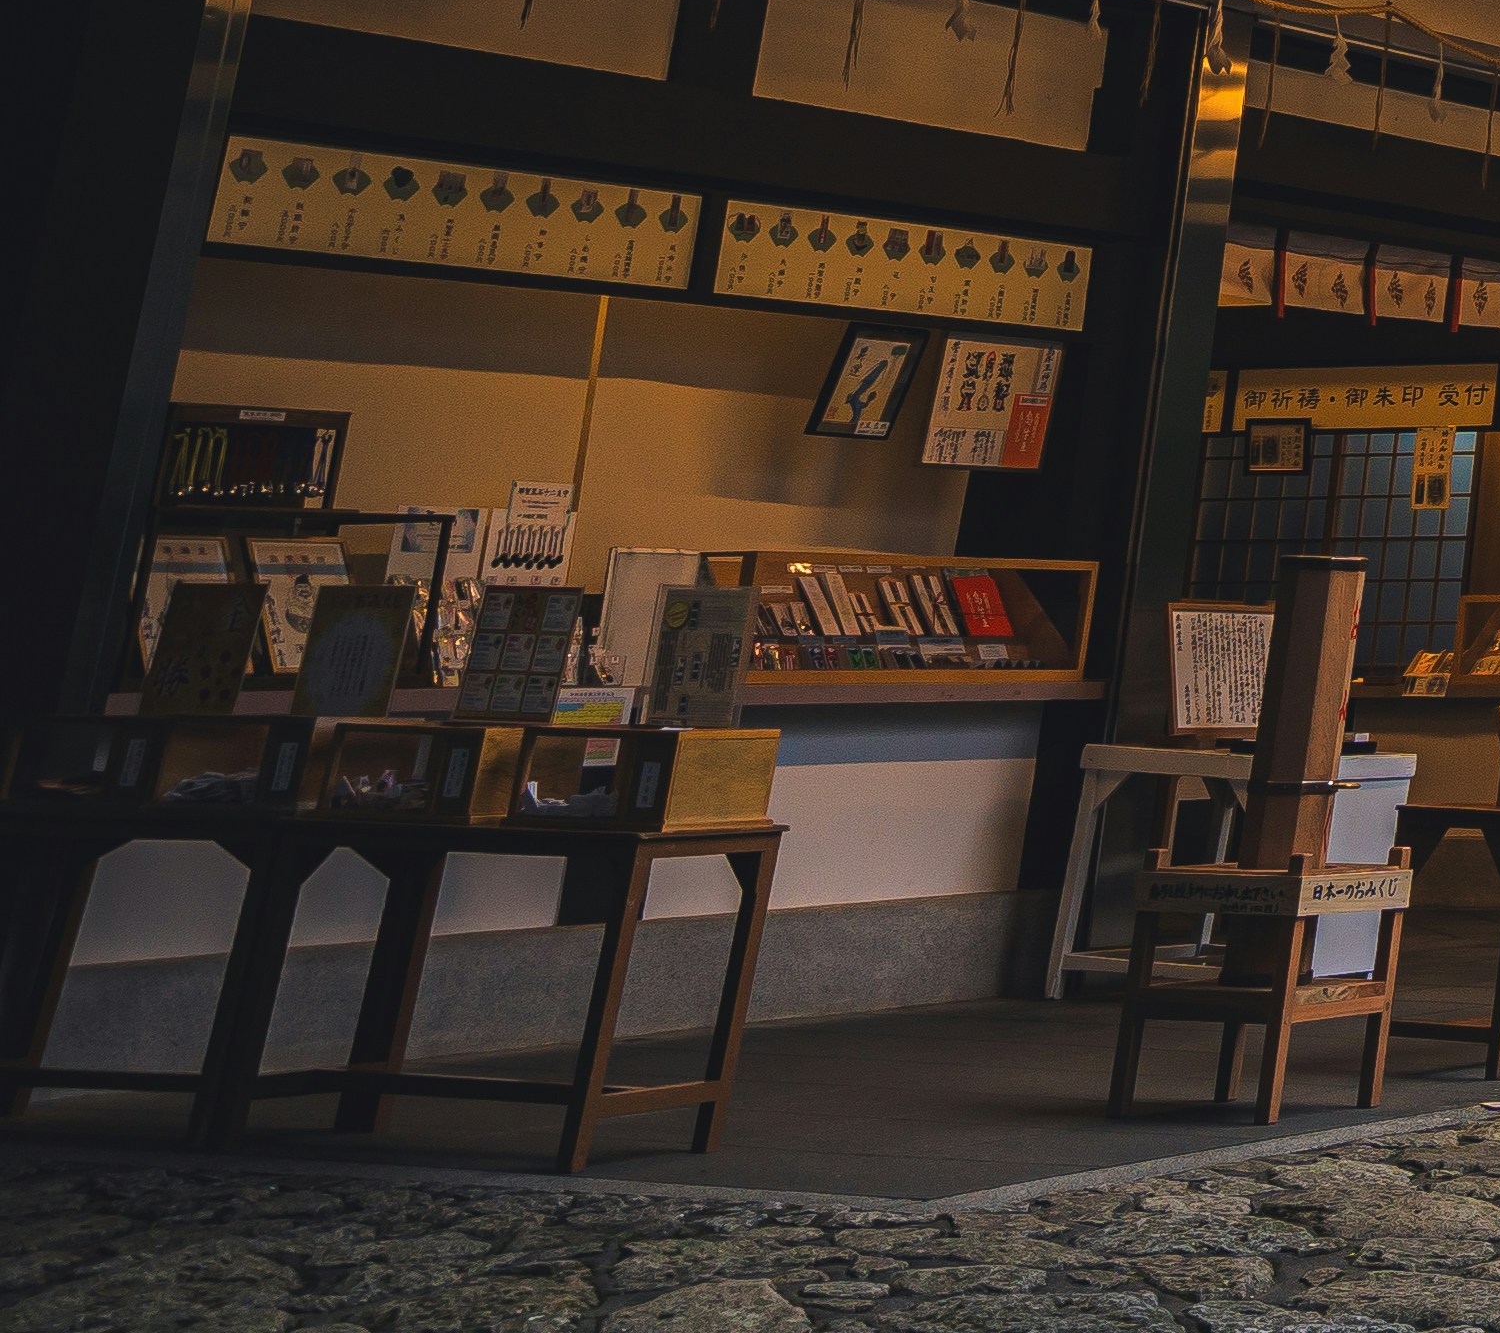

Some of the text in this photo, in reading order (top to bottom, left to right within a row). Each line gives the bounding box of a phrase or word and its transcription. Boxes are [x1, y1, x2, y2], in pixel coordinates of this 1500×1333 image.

[1438, 383, 1491, 407] 受付
[1312, 878, 1399, 901] 日本一のおみくじ
